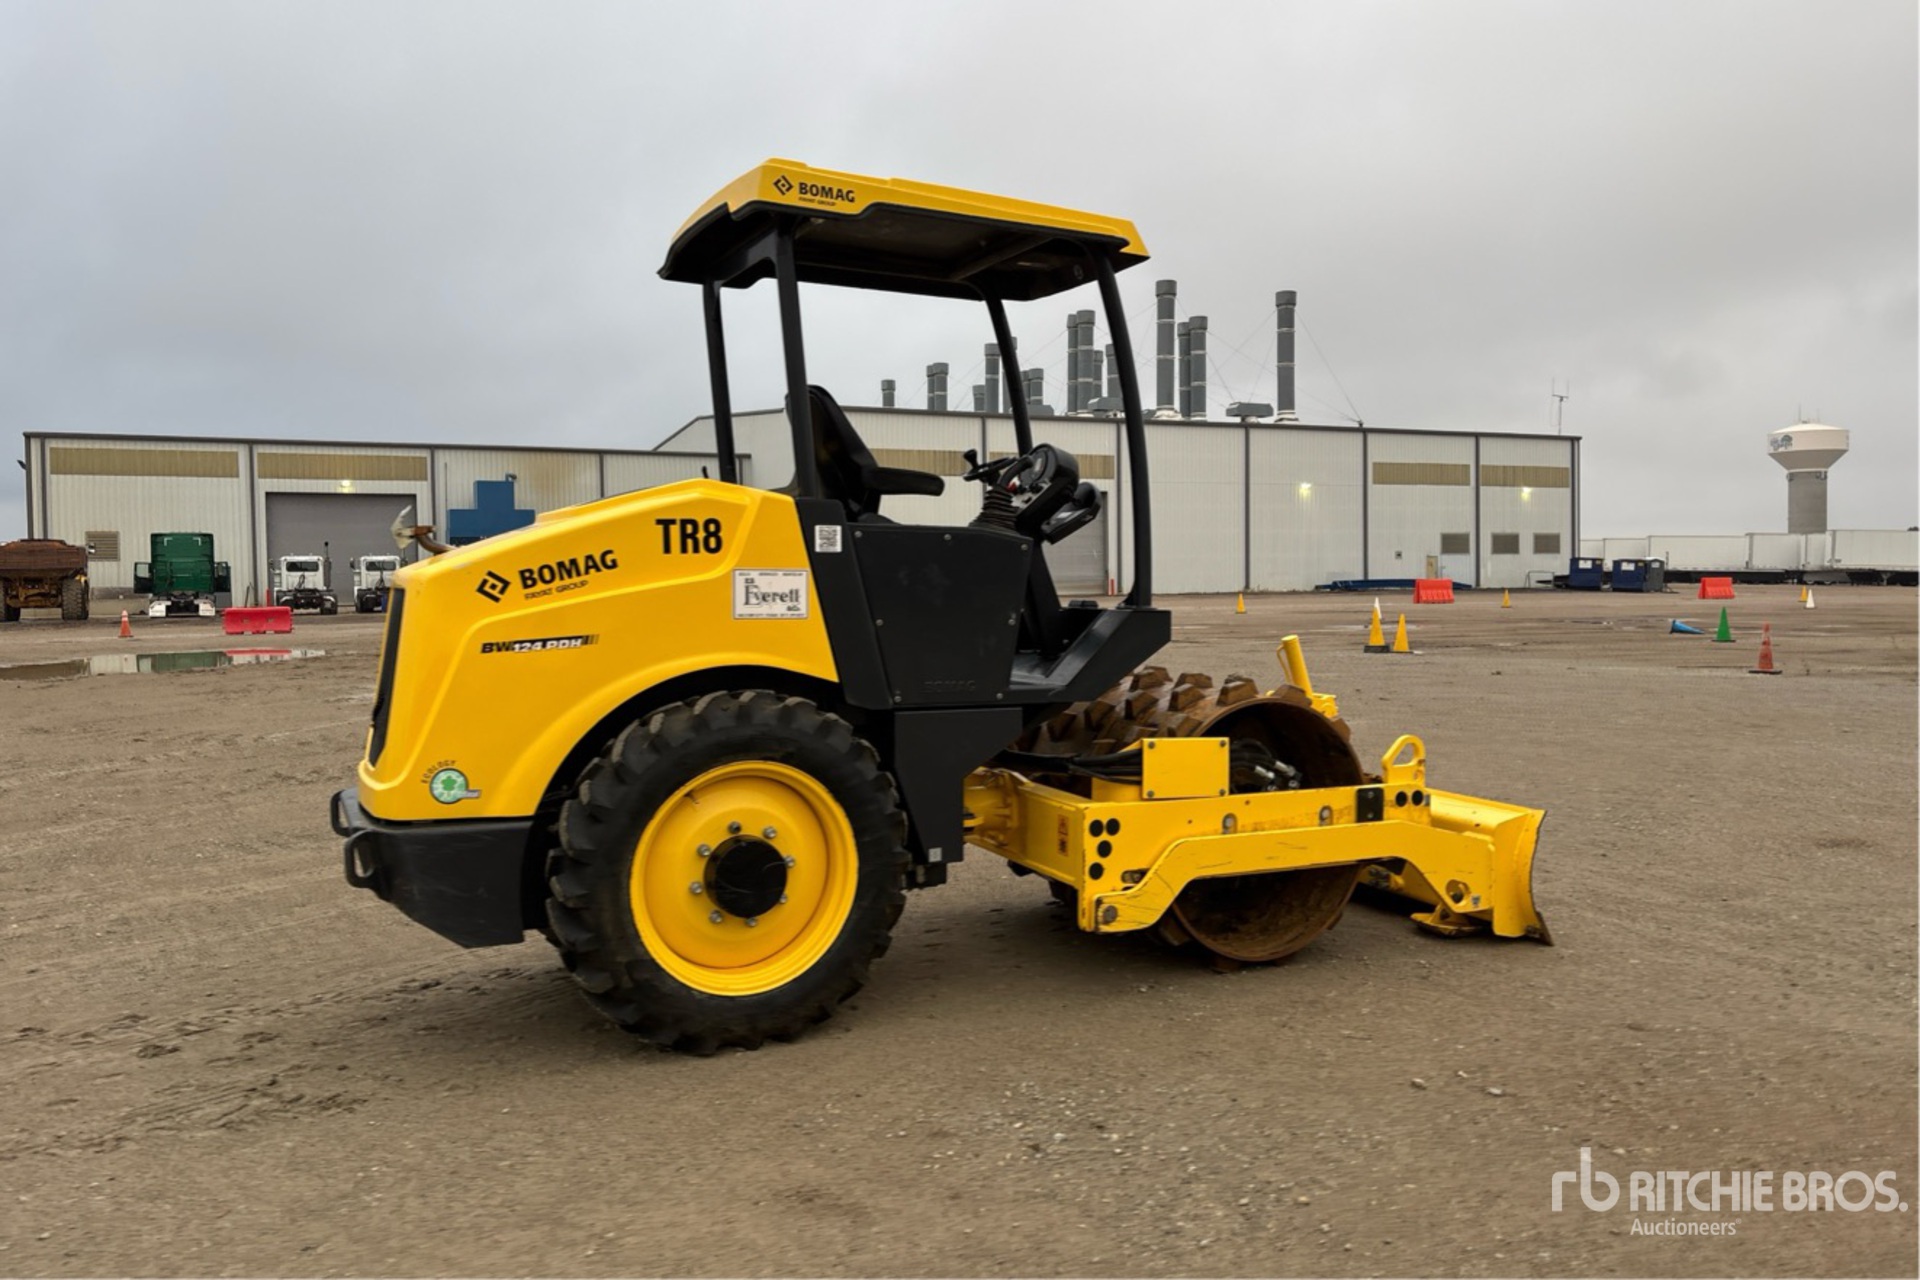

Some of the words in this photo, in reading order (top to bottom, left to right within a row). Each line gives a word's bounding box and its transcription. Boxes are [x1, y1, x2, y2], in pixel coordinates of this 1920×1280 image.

[798, 182, 855, 203] BOMAG
[655, 517, 723, 554] TR8
[518, 549, 618, 589] BOMAG
[545, 637, 583, 650] PDH
